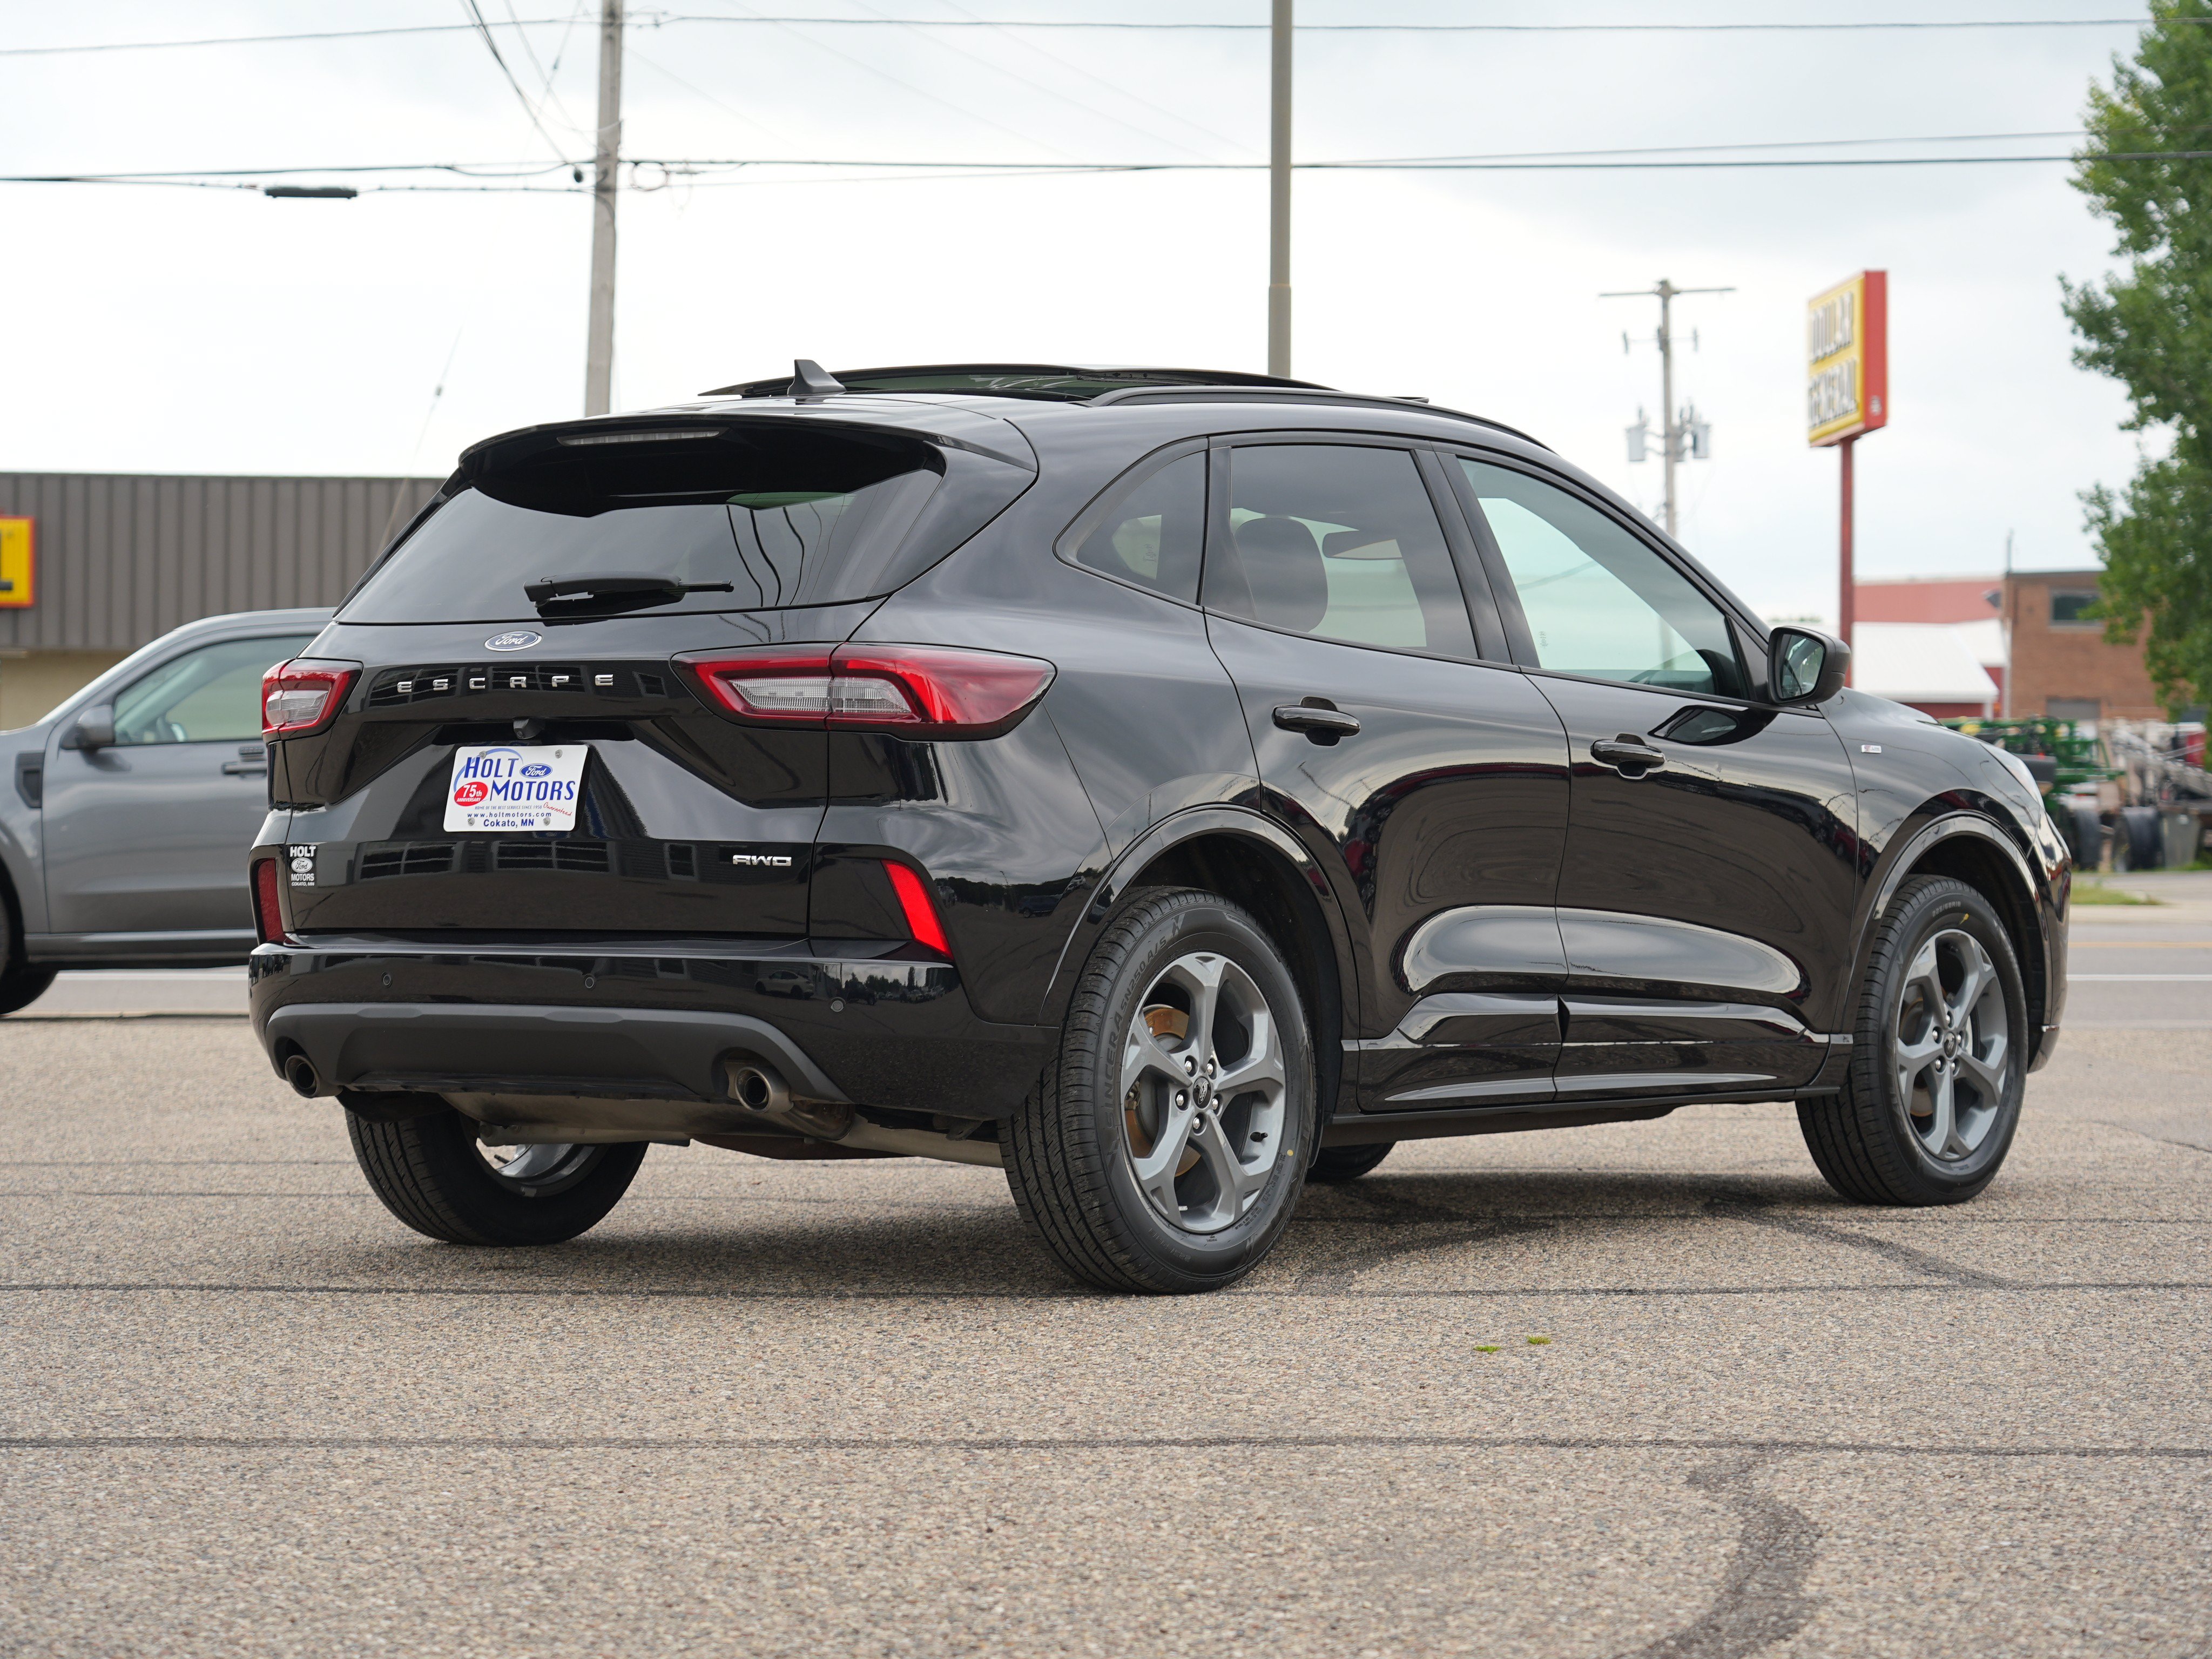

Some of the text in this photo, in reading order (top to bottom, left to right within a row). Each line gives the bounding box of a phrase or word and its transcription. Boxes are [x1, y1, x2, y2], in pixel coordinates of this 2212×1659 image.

[495, 633, 529, 645] Ford
[397, 674, 613, 693] ESCAPE
[464, 757, 519, 778] HOLT
[525, 765, 547, 777] Ford
[463, 785, 482, 798] 75th
[490, 779, 576, 801] MOTORS
[543, 802, 572, 817] Guaranteed
[483, 819, 518, 828] Cokato,
[289, 846, 316, 857] HOLT
[295, 860, 308, 869] Ford
[733, 855, 792, 866] AWD
[291, 873, 314, 881] MOTORS
[1106, 936, 1166, 1129] SINCERA SN250 A/S
